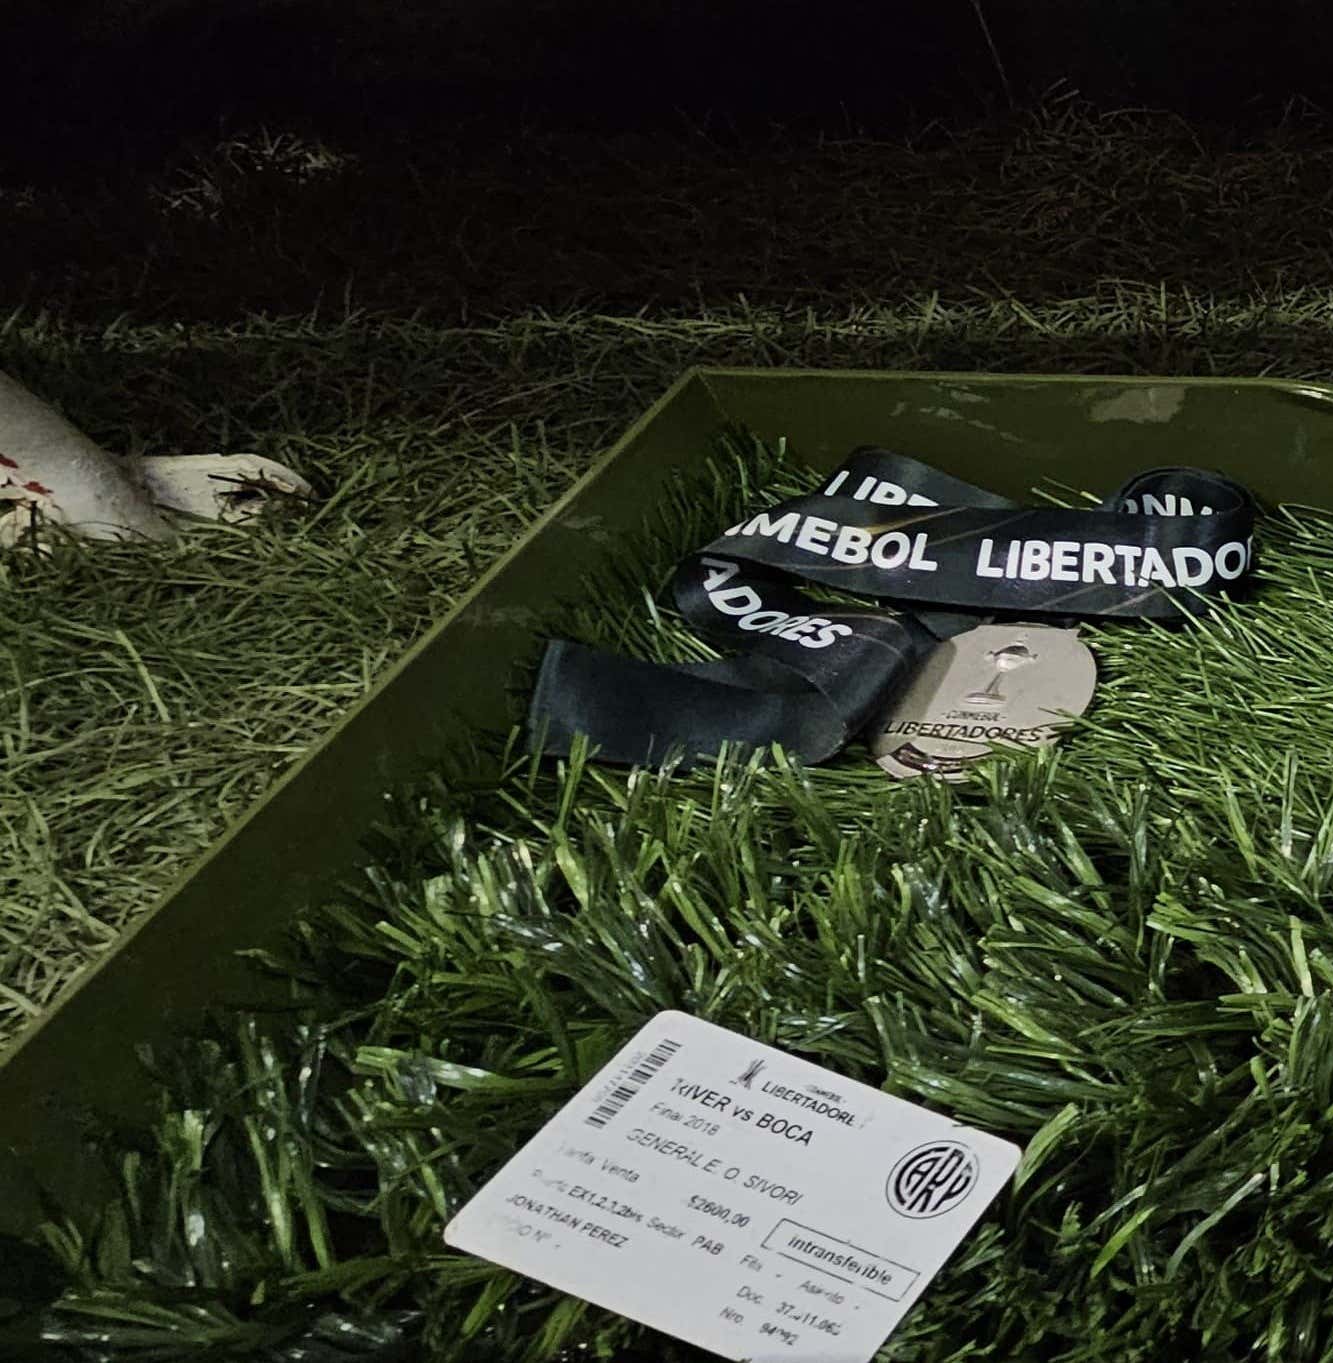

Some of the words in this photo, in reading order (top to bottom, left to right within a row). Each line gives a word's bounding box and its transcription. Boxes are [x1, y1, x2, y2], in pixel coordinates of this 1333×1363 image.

[884, 720, 1044, 742] LIBERTADORES
[682, 1114, 723, 1138] 2018
[732, 1105, 755, 1122] vs
[755, 1112, 815, 1147] BOCA
[743, 1174, 804, 1206] SIVORI
[581, 1221, 631, 1249] PEREZ
[691, 1234, 725, 1256] PAB
